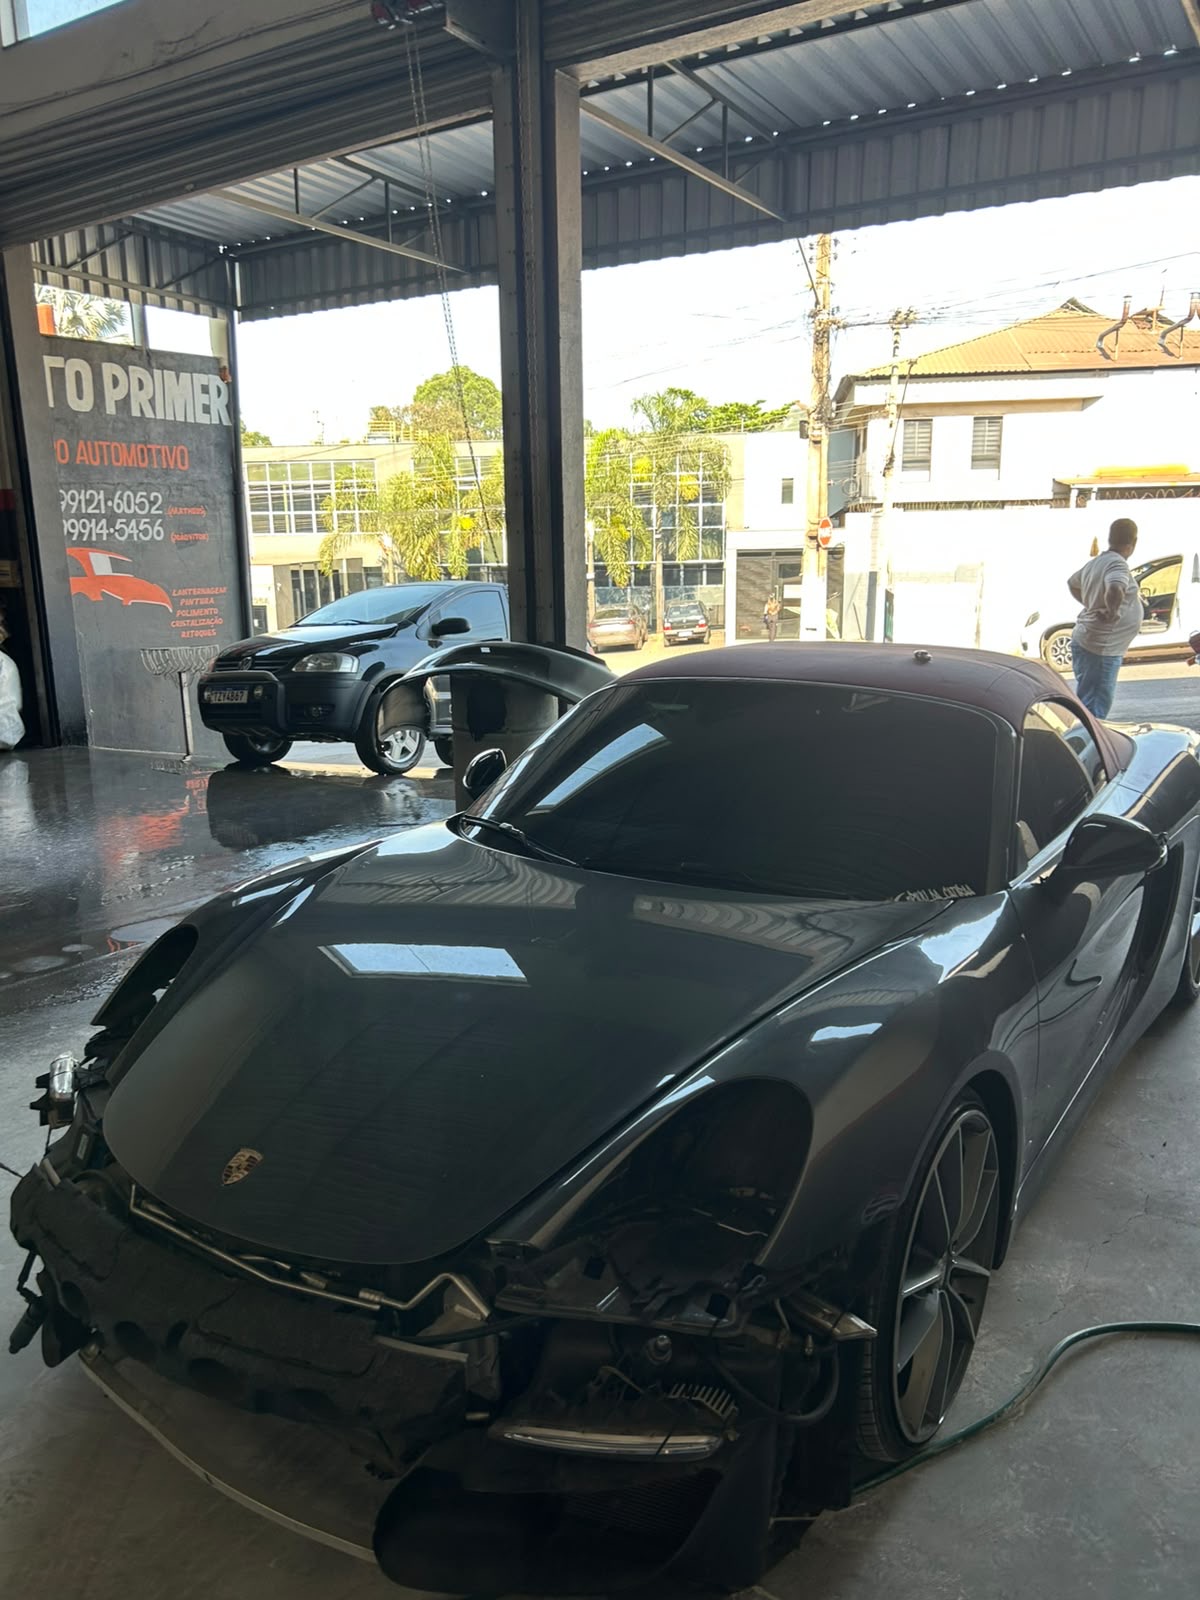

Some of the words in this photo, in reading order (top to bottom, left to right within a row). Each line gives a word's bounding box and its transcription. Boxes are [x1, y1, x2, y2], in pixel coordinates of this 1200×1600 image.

[102, 362, 232, 426] PRIMER
[54, 439, 69, 465] O
[76, 440, 190, 471] AUTOMOTIVO
[176, 608, 219, 617] POLIMENTO
[180, 598, 215, 607] PINTURA
